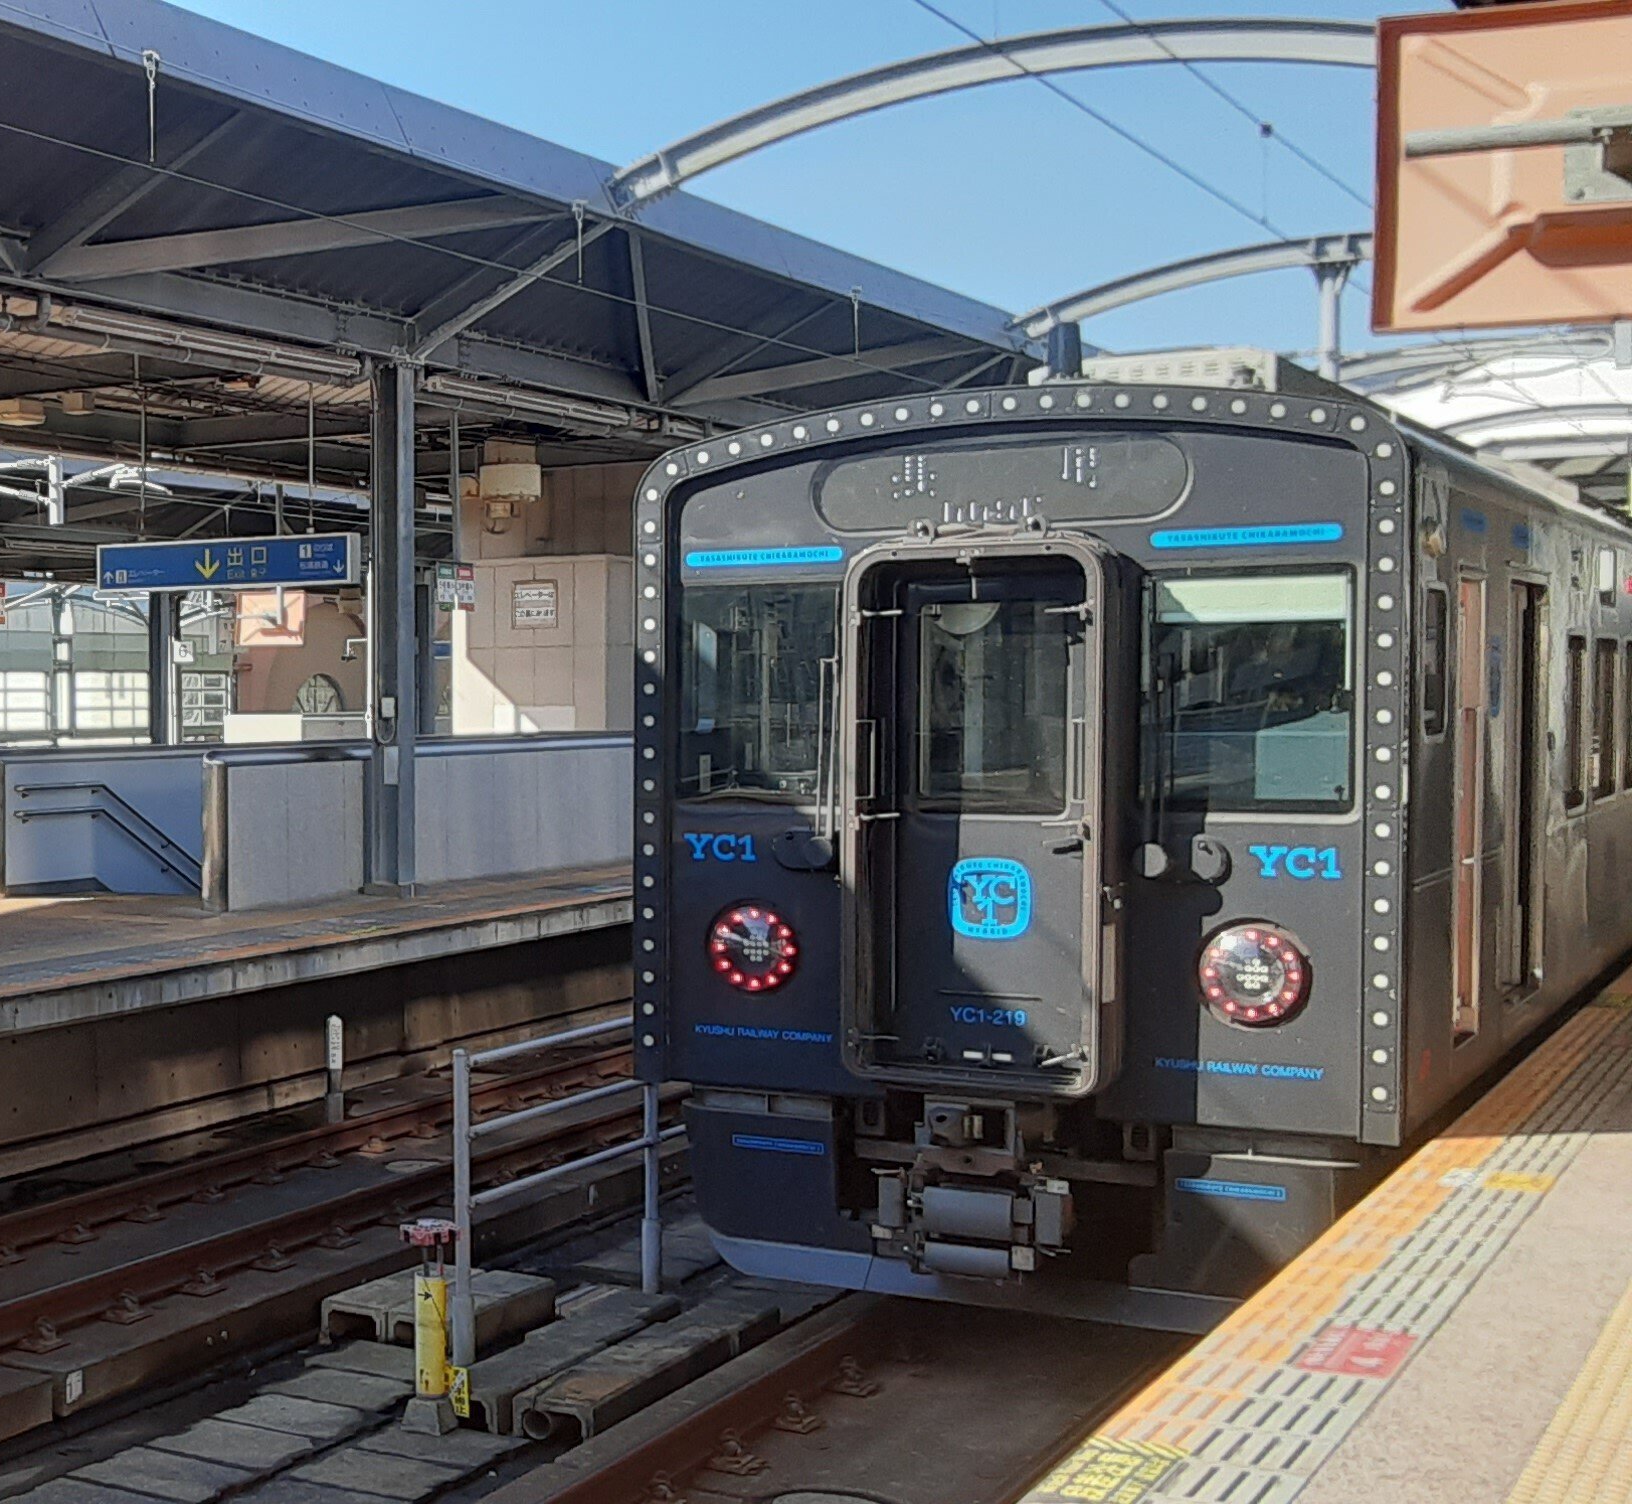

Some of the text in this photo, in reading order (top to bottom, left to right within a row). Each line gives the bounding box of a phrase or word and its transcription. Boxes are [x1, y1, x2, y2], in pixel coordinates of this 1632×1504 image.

[227, 546, 267, 566] 出口
[683, 833, 757, 861] YC1
[1249, 845, 1343, 879] YC1
[949, 1005, 1027, 1027] YC1-219
[694, 1023, 833, 1043] KYUSHU RAILWAY COMPANY
[1154, 1057, 1324, 1080] KYUSHU RAILWAY COMPANY
